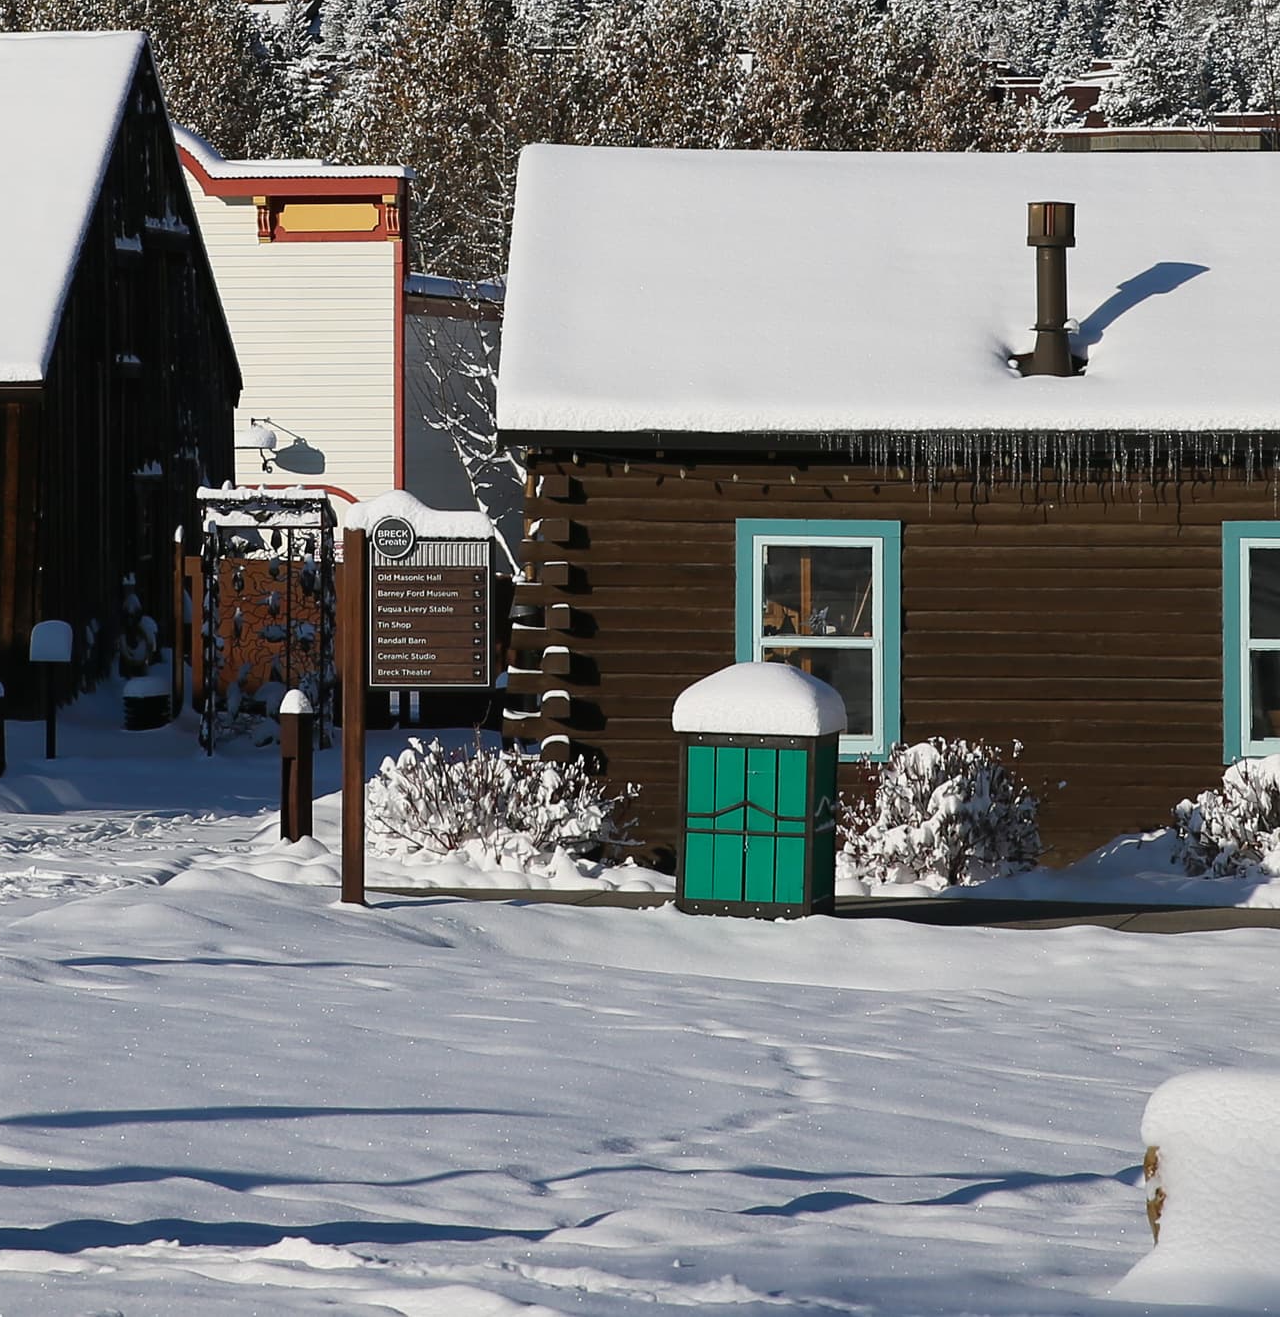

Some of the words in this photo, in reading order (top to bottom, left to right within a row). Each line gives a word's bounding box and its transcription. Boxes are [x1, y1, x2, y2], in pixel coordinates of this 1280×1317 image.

[377, 529, 409, 538] BRECK
[378, 538, 408, 546] Create
[377, 590, 405, 598] Barney
[403, 606, 428, 614] Livery
[391, 621, 412, 629] Shop
[377, 652, 409, 660] Ceramic
[410, 652, 437, 660] Studio
